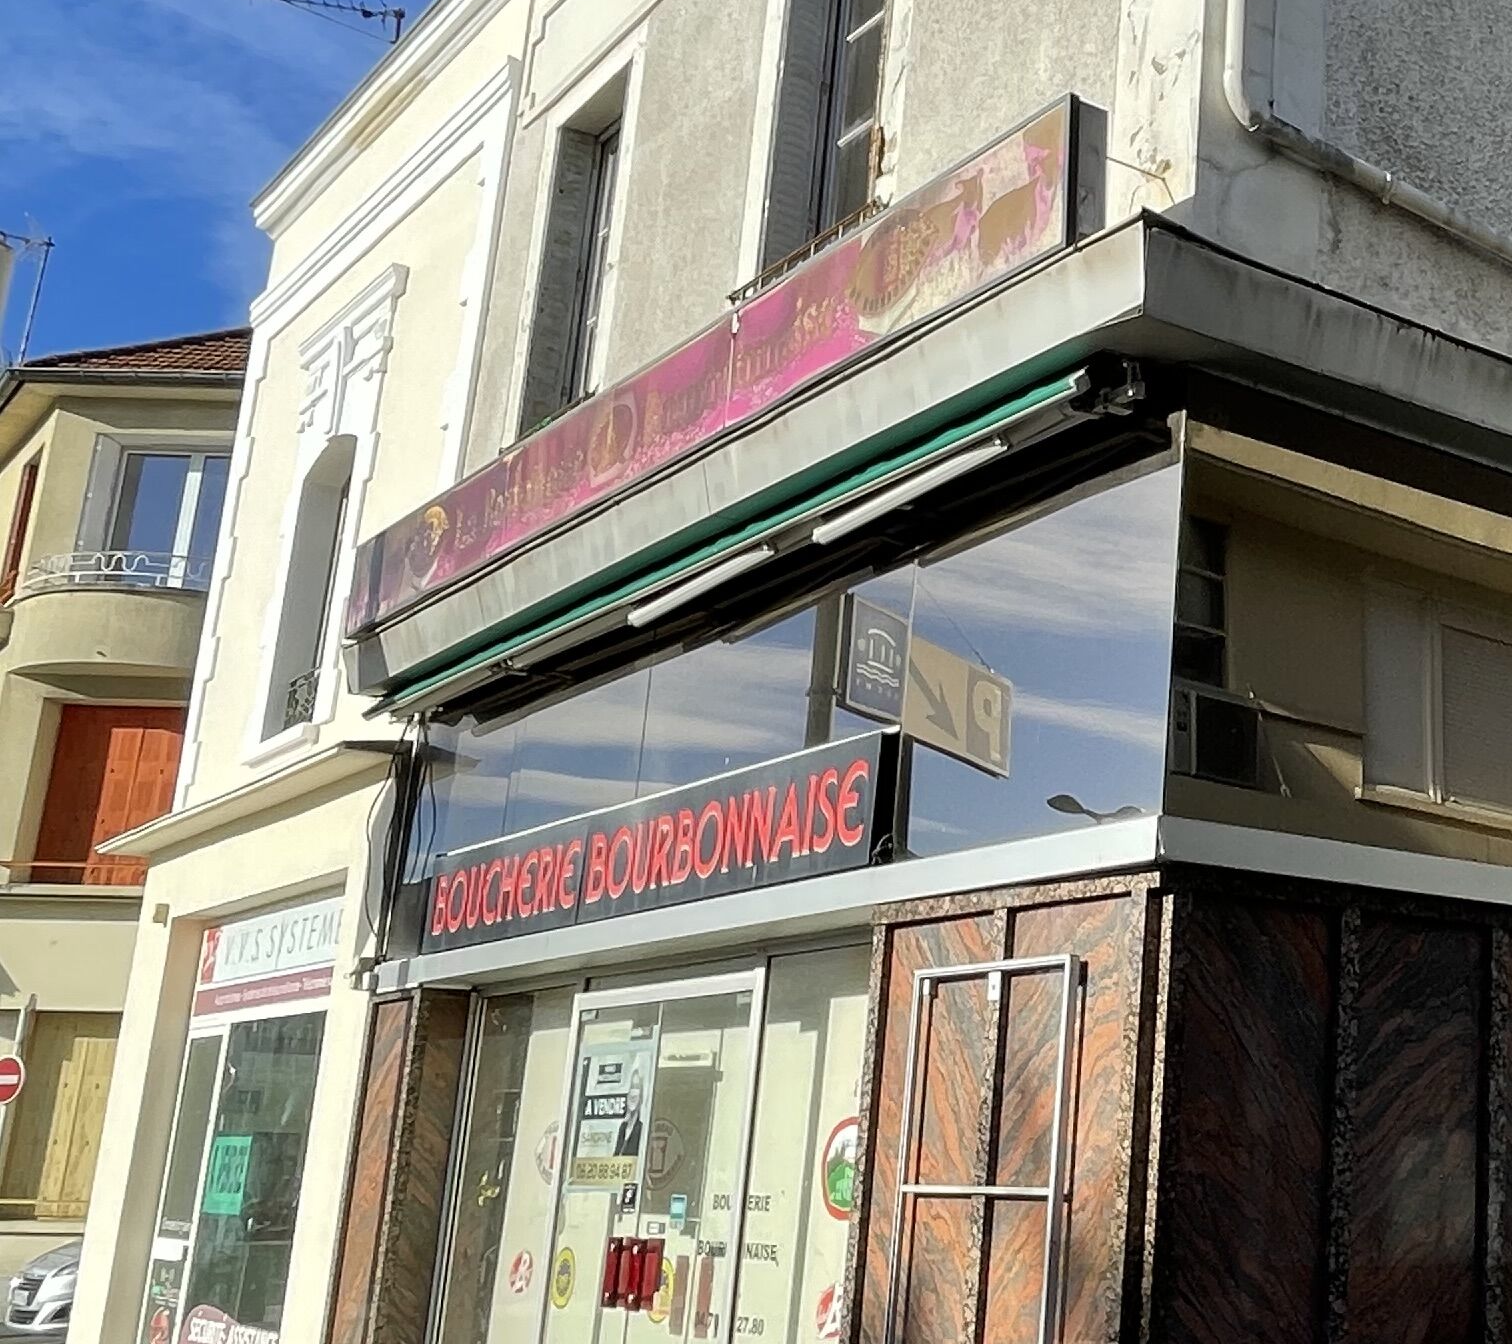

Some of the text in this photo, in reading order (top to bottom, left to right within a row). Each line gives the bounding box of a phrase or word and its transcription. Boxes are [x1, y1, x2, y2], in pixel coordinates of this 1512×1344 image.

[431, 759, 870, 936] BOUCHERIE BOURBONNAISE
[584, 1096, 626, 1116] A VENDRE
